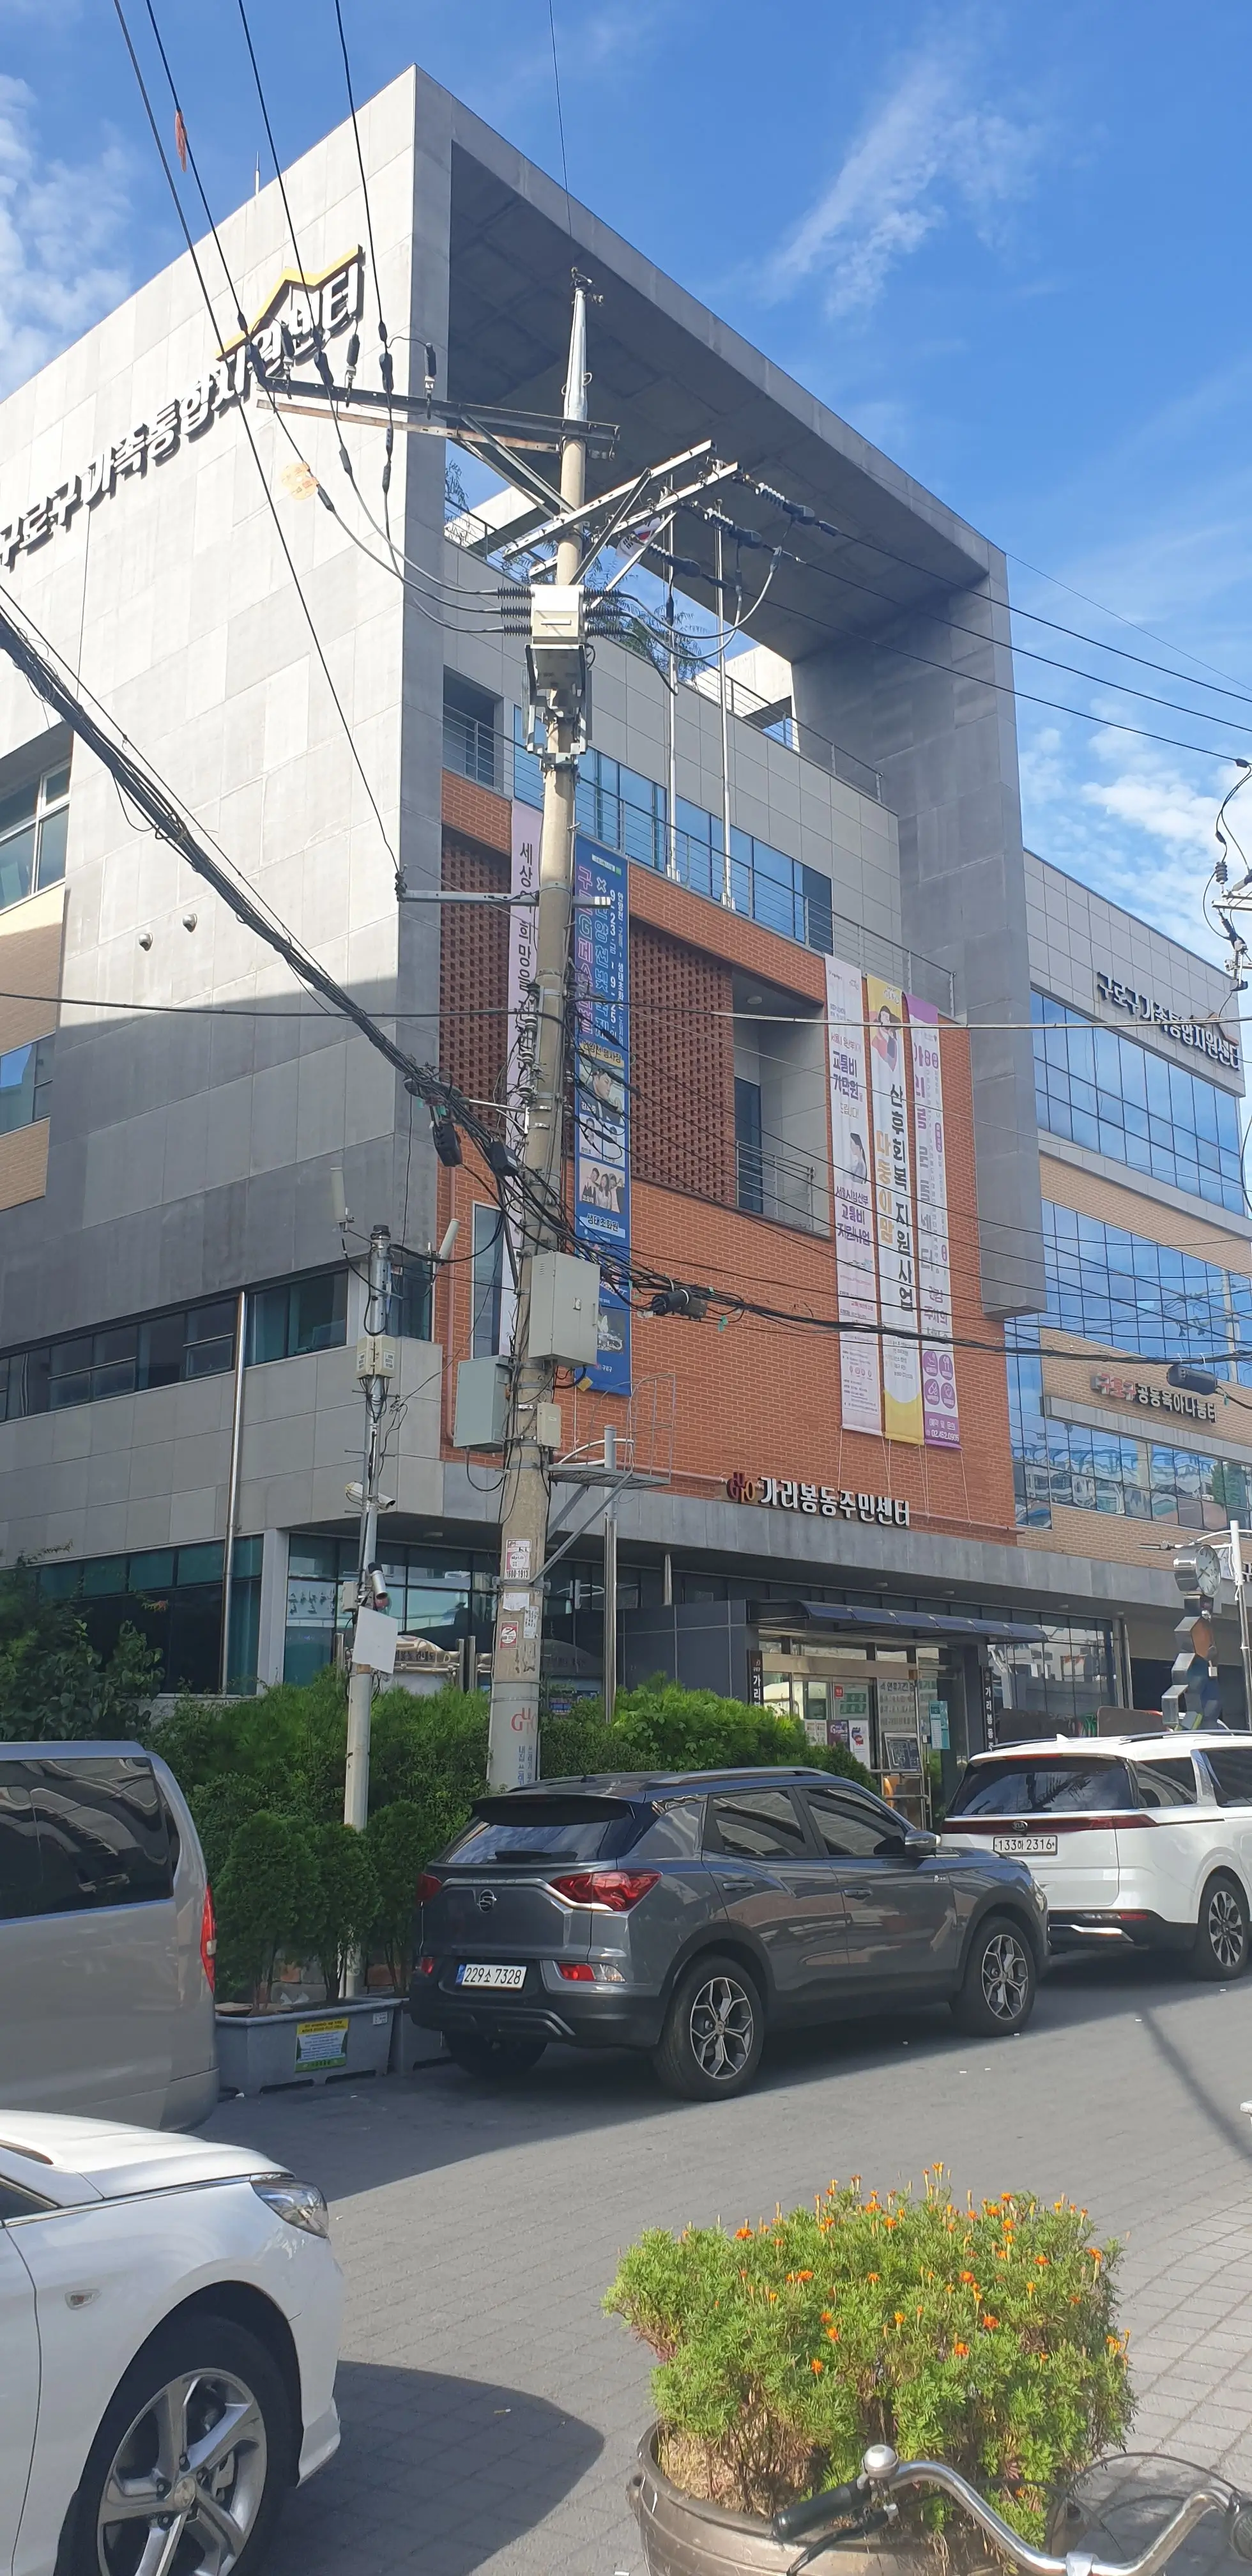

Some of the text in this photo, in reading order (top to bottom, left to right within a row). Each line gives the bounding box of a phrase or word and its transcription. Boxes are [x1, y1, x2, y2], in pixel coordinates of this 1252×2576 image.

[587, 1213, 619, 1232] 생태초화원
[759, 1476, 910, 1527] 가리봉동주민센터
[1026, 1837, 1053, 1851] 2316
[464, 1966, 522, 1985] 229소 7328
